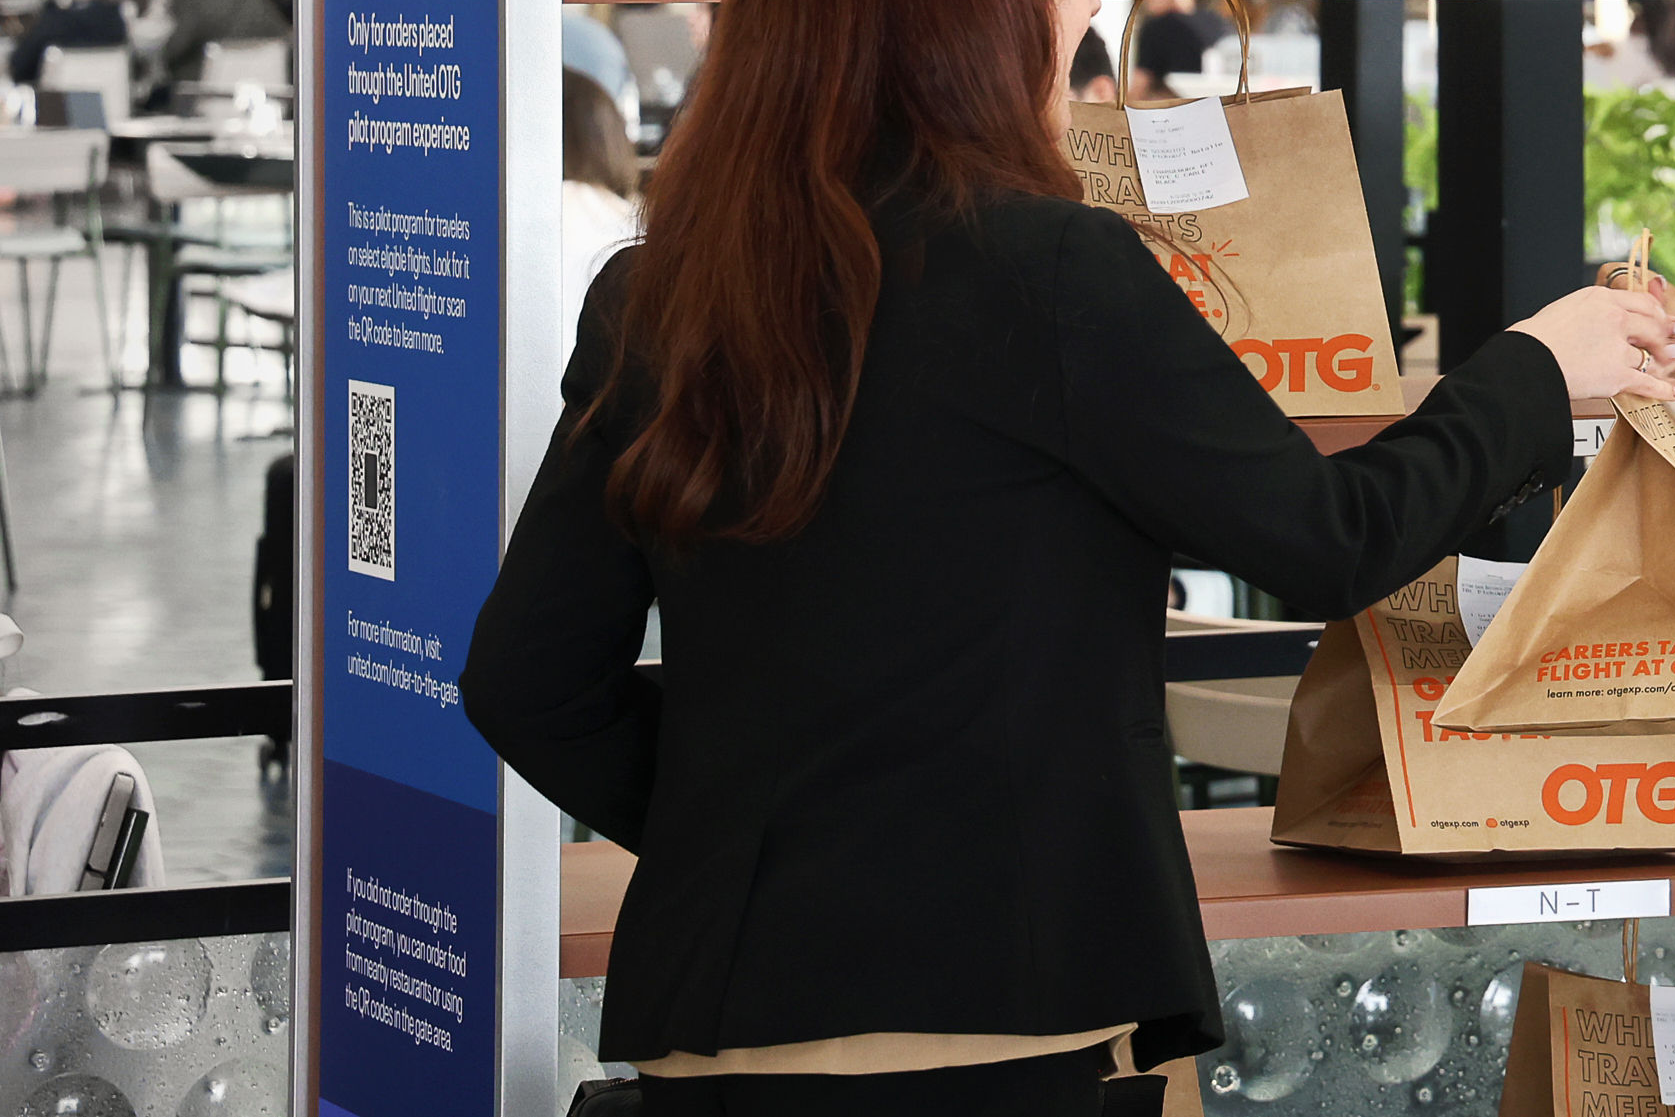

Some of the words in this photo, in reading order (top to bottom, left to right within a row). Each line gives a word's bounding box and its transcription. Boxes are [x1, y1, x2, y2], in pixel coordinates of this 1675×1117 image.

[348, 12, 369, 54] Only
[371, 12, 385, 46] for
[386, 13, 417, 47] orders
[419, 14, 453, 56] placed
[348, 61, 385, 104] through
[386, 62, 402, 96] the
[404, 63, 437, 98] United
[438, 64, 461, 100] OTG
[348, 110, 369, 151] pilot
[370, 118, 412, 154] program
[413, 116, 470, 156] experience
[348, 201, 362, 229] This
[362, 205, 369, 230] is
[375, 205, 391, 236] pilot
[391, 211, 424, 241] program
[424, 209, 436, 236] for
[436, 212, 470, 241] travelers
[348, 247, 358, 266] on
[358, 241, 380, 269] select
[381, 244, 407, 277] eligible
[408, 246, 433, 280] flights.
[433, 249, 451, 277] Look
[451, 251, 464, 279] for
[464, 254, 470, 280] it
[348, 284, 358, 303] on
[358, 285, 375, 310] your
[375, 286, 391, 308] next
[392, 282, 417, 311] United
[417, 286, 437, 320] flight
[437, 296, 446, 316] or
[446, 297, 466, 318] scan
[348, 315, 361, 341] the
[361, 316, 373, 347] QR
[373, 320, 393, 347] code
[393, 325, 401, 348] to
[402, 322, 420, 350] learn
[421, 332, 444, 354] more.
[1229, 333, 1374, 392] OTG
[348, 610, 359, 638] For
[359, 624, 379, 644] more
[379, 620, 424, 661] information,
[424, 634, 442, 661] visit:
[1540, 641, 1649, 664] CAREERS
[348, 652, 459, 708] united.com/order-to-the-gate
[1536, 661, 1626, 682] FLIGHT
[1632, 659, 1665, 676] AT
[1547, 689, 1573, 699] learn
[1575, 688, 1604, 698] more:
[1430, 820, 1479, 830] otgexp.com
[1500, 819, 1530, 829] otgexp
[346, 867, 352, 892] If
[352, 878, 366, 901] you
[367, 875, 379, 904] did
[379, 886, 392, 909] not
[392, 887, 412, 917] order
[413, 893, 443, 934] through
[444, 905, 457, 934] the
[346, 908, 361, 937] pilot
[362, 919, 396, 955] program,
[396, 932, 411, 958] you
[411, 937, 426, 961] can
[426, 941, 448, 969] order
[448, 945, 466, 978] food
[346, 943, 364, 974] from
[364, 957, 389, 991] nearby
[389, 968, 432, 1006] restaurants
[432, 986, 442, 1007] or
[442, 987, 463, 1023] using
[345, 983, 358, 1011] the
[358, 986, 370, 1018] QR
[370, 997, 394, 1028] codes
[393, 1003, 401, 1030] in
[401, 1006, 414, 1035] the
[415, 1019, 433, 1046] gate
[433, 1026, 453, 1053] area.
